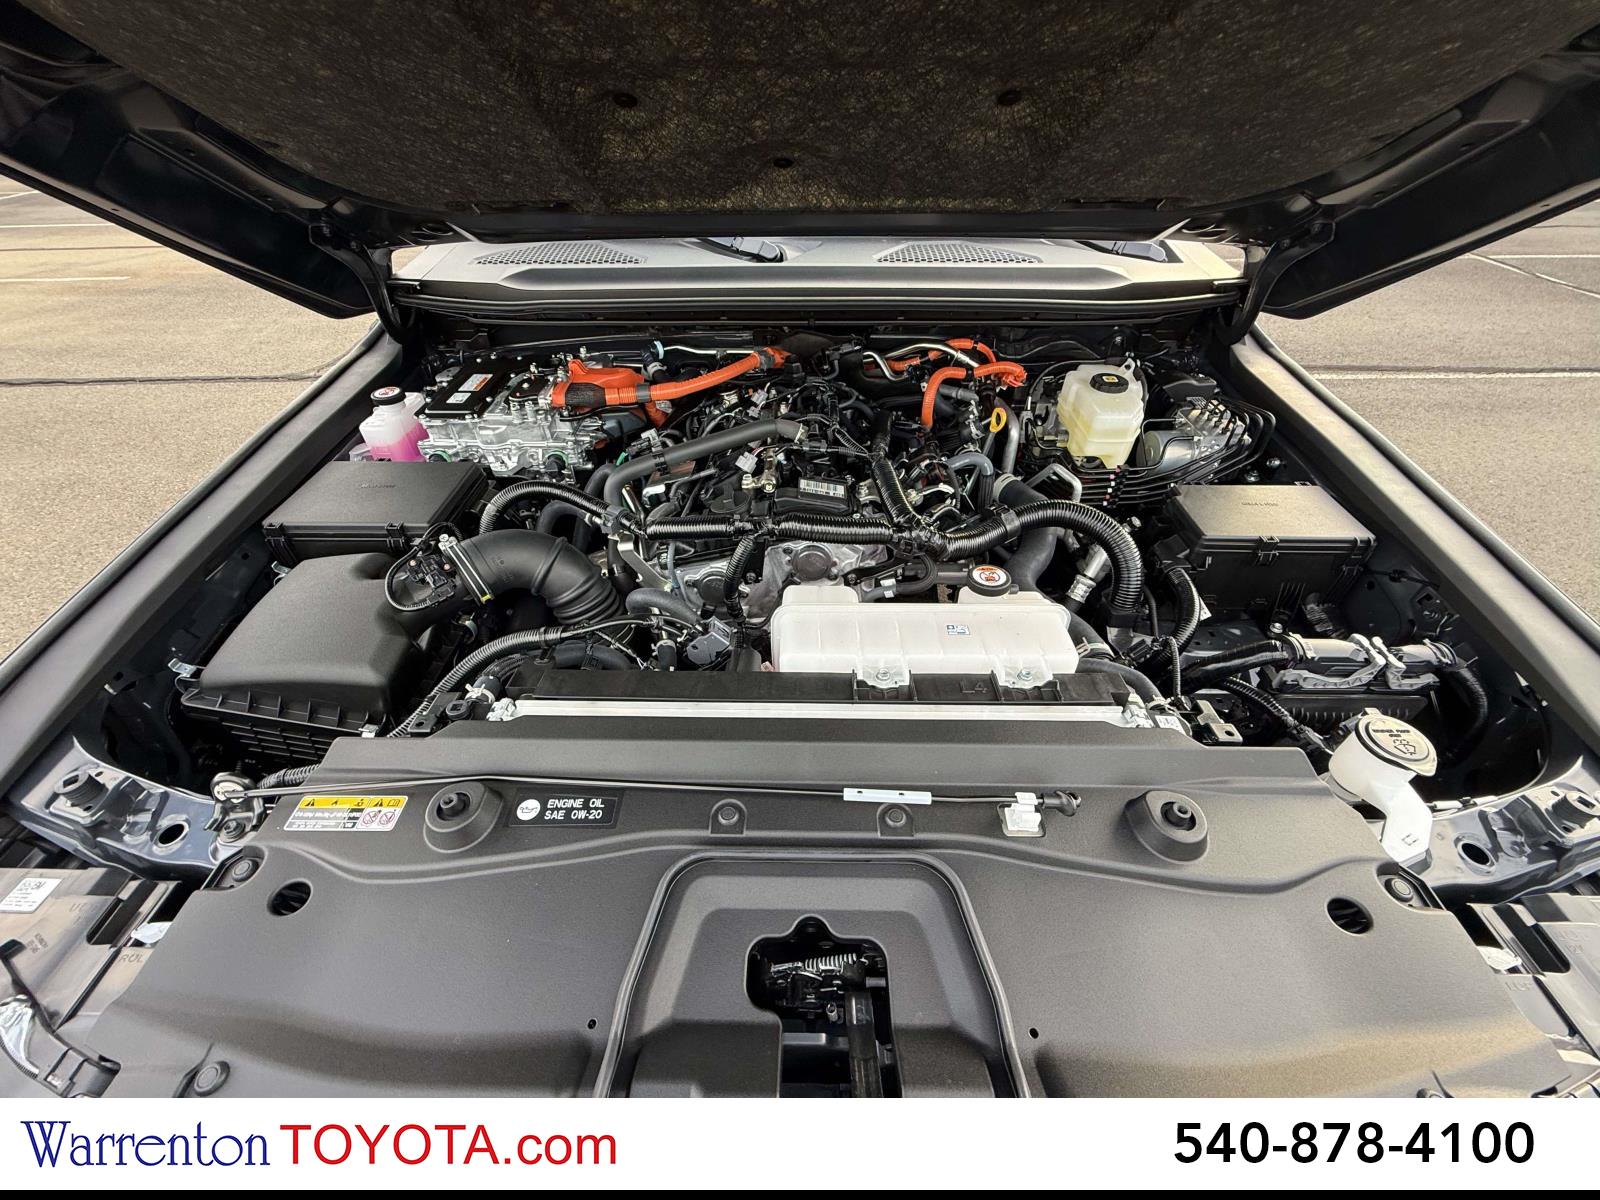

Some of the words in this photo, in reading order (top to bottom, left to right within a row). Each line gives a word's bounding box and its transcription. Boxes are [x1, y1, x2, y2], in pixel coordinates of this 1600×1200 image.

[547, 798, 585, 809] ENGINE
[589, 798, 605, 808] OIL
[544, 810, 566, 820] SAE
[570, 809, 603, 820] 0W-20
